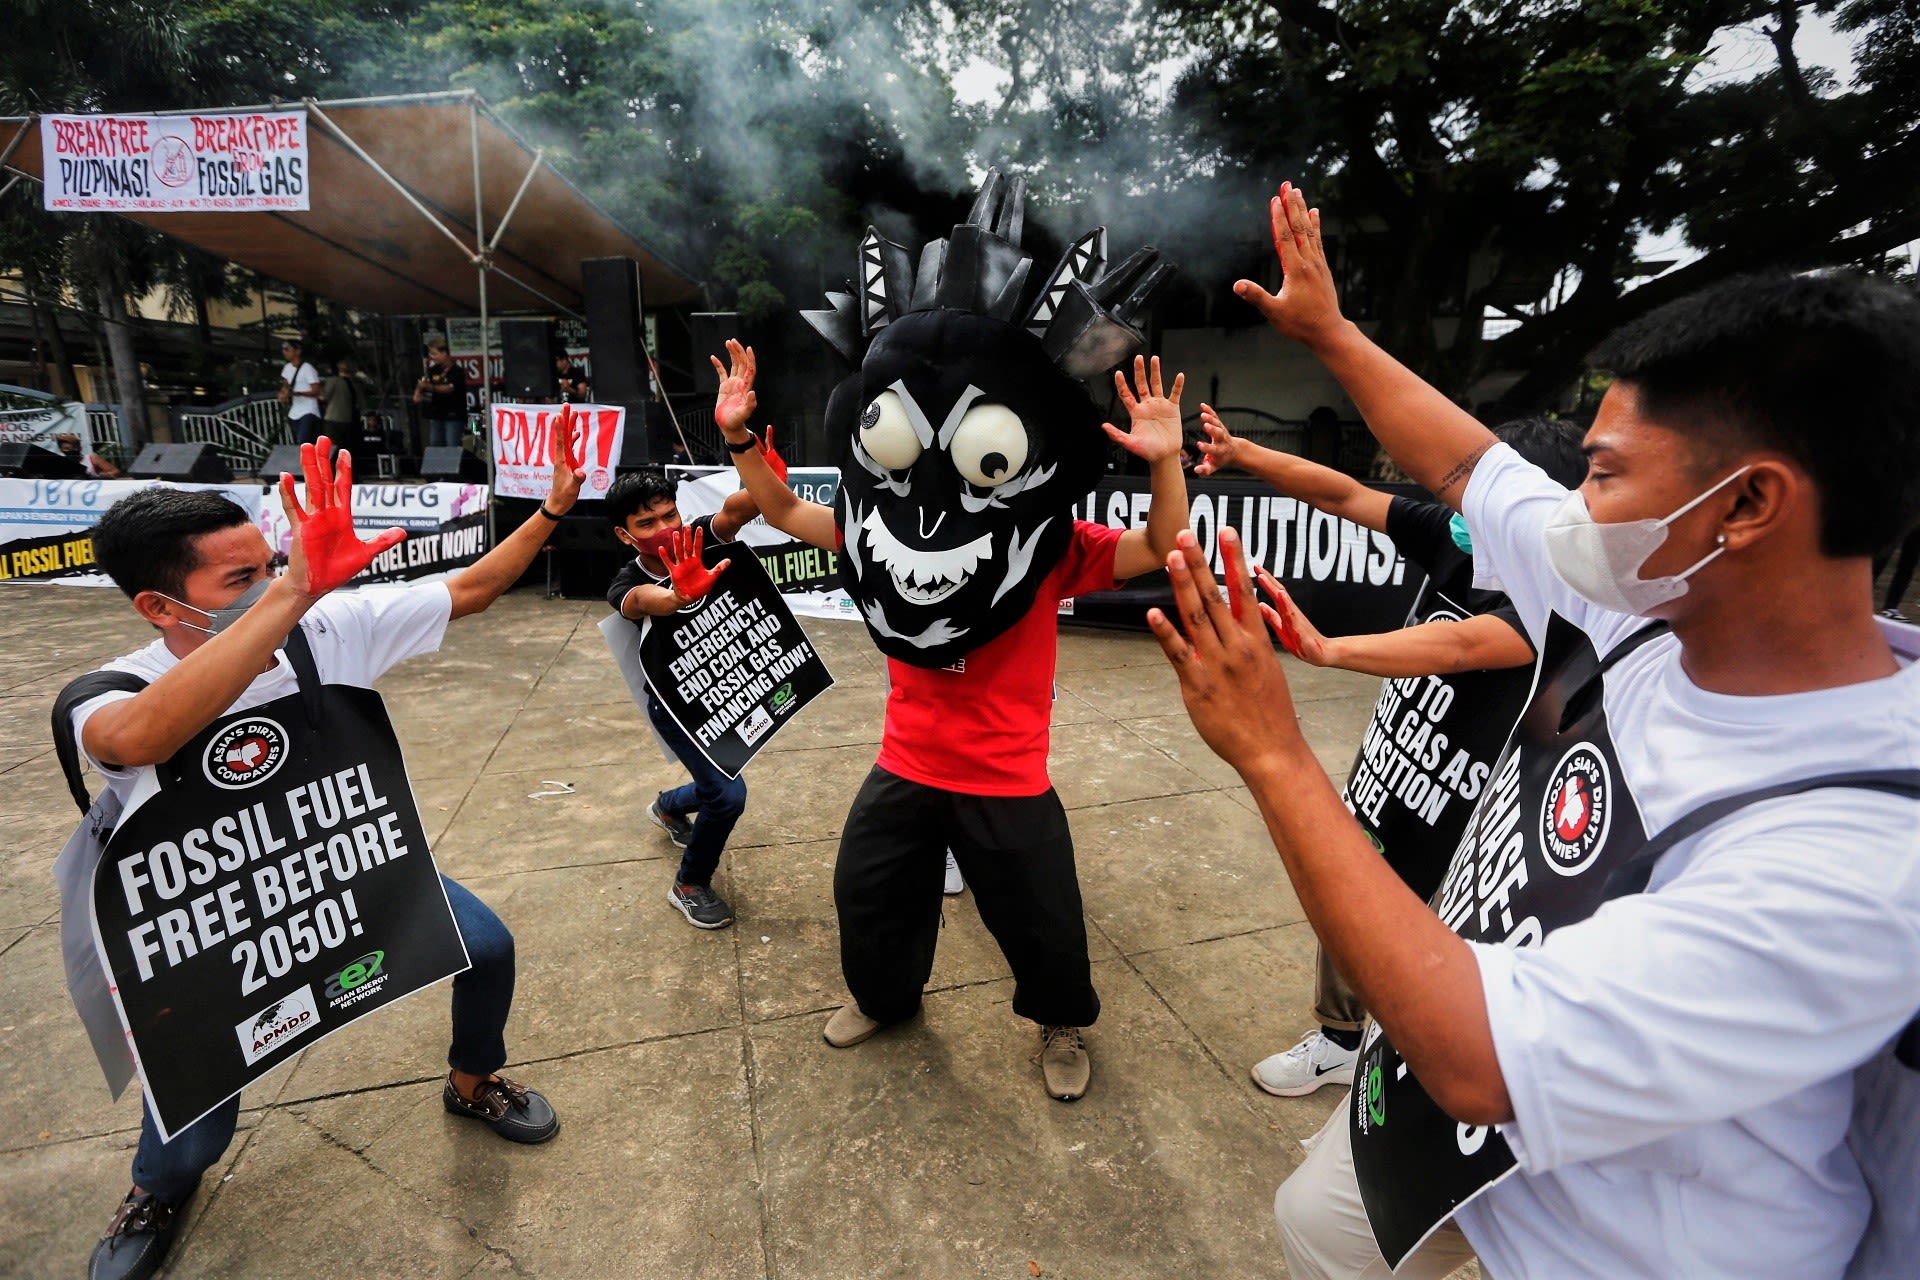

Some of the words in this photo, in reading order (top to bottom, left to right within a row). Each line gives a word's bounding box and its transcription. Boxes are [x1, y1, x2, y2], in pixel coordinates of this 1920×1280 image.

[260, 156, 302, 196] GAS
[356, 485, 439, 508] MUFG
[410, 519, 438, 527] GROUP
[12, 545, 63, 577] FOSSIL
[407, 534, 441, 567] EXIT
[441, 525, 484, 560] NOW!
[785, 548, 826, 581] FUEL
[668, 598, 768, 682] EMERGENCY!
[673, 590, 740, 650] CLIMATE
[676, 668, 712, 705] END
[709, 640, 751, 678] COAL
[747, 614, 782, 649] AND
[699, 661, 754, 714] FOSSIL
[749, 638, 783, 673] GAS
[695, 672, 774, 748] FINANCING
[768, 642, 813, 683] NOW!
[1416, 675, 1455, 723] TO
[213, 728, 245, 763] ASIA'S
[248, 725, 279, 744] DIRTY
[747, 718, 769, 740] APMDD
[216, 745, 280, 782] COMPANIES
[1362, 720, 1452, 827] ANSITION
[1395, 709, 1449, 771] GAS
[1438, 748, 1490, 801] AS
[1566, 756, 1600, 784] ASIA'S
[1350, 760, 1390, 828] FUEL
[117, 802, 287, 917] FOSSIL
[285, 763, 388, 841] FUEL
[1546, 777, 1581, 860] COMPANIES
[1583, 785, 1603, 850] DIRTY
[127, 880, 251, 983] FREE
[253, 812, 409, 919] BEFORE
[231, 889, 364, 997] 2050!
[329, 990, 355, 1008] ASIAN
[355, 973, 389, 993] ENERGY
[340, 984, 383, 1010] NETWORK
[252, 1010, 311, 1053] APMDD
